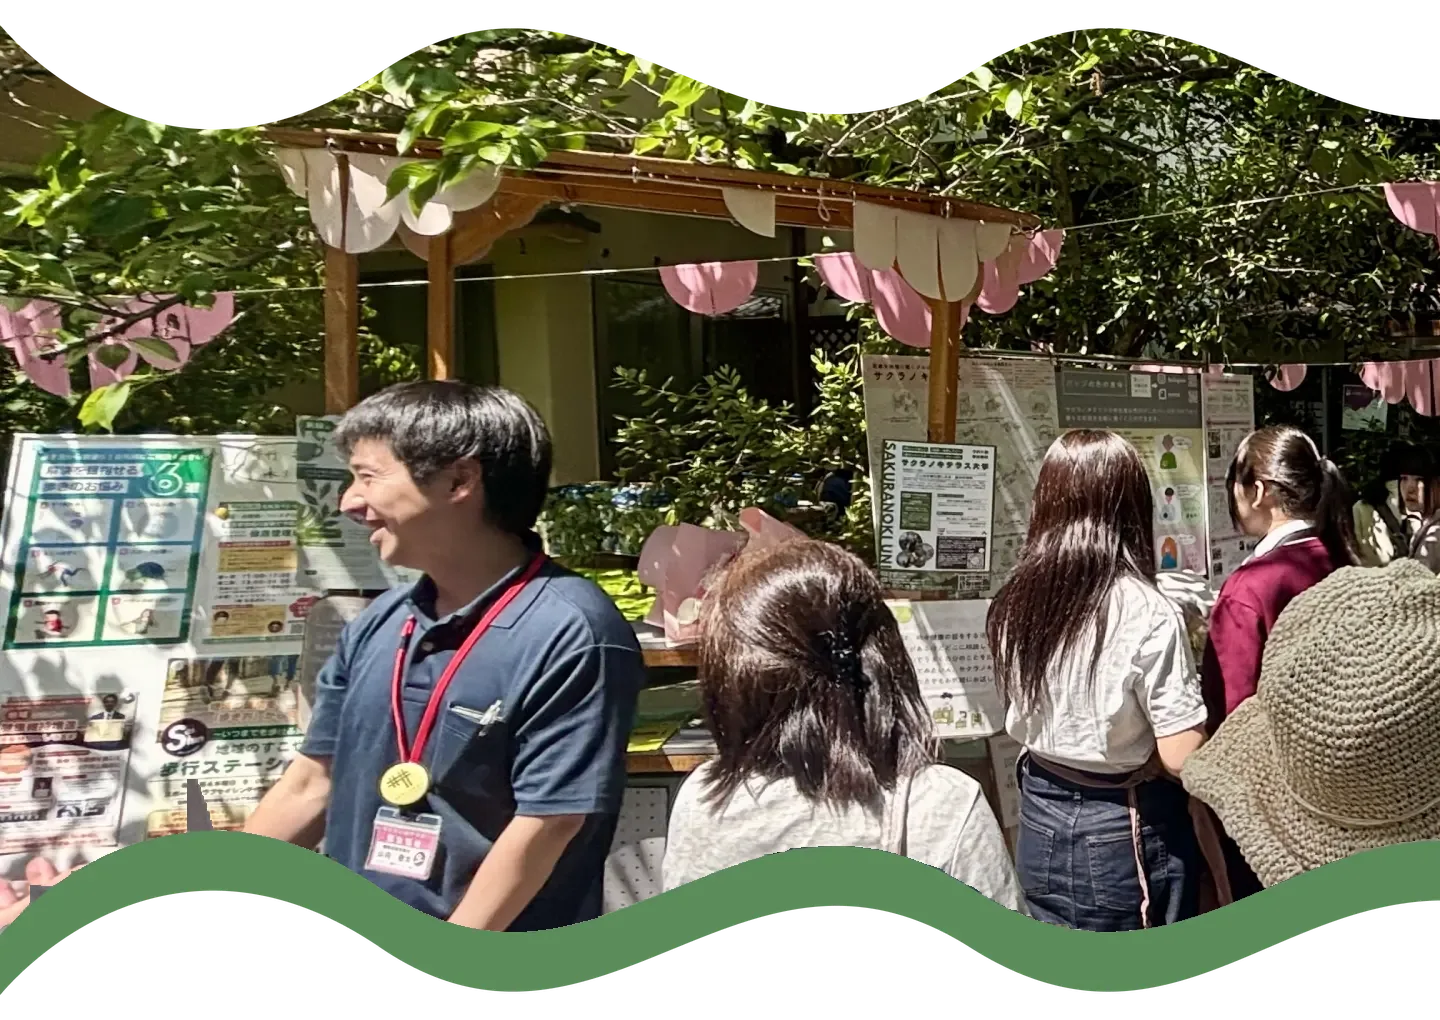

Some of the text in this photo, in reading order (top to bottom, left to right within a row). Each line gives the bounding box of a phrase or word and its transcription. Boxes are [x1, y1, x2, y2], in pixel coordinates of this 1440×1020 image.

[882, 441, 896, 538] SAKURANOKI
[901, 459, 989, 470] サクラノキテラス大学
